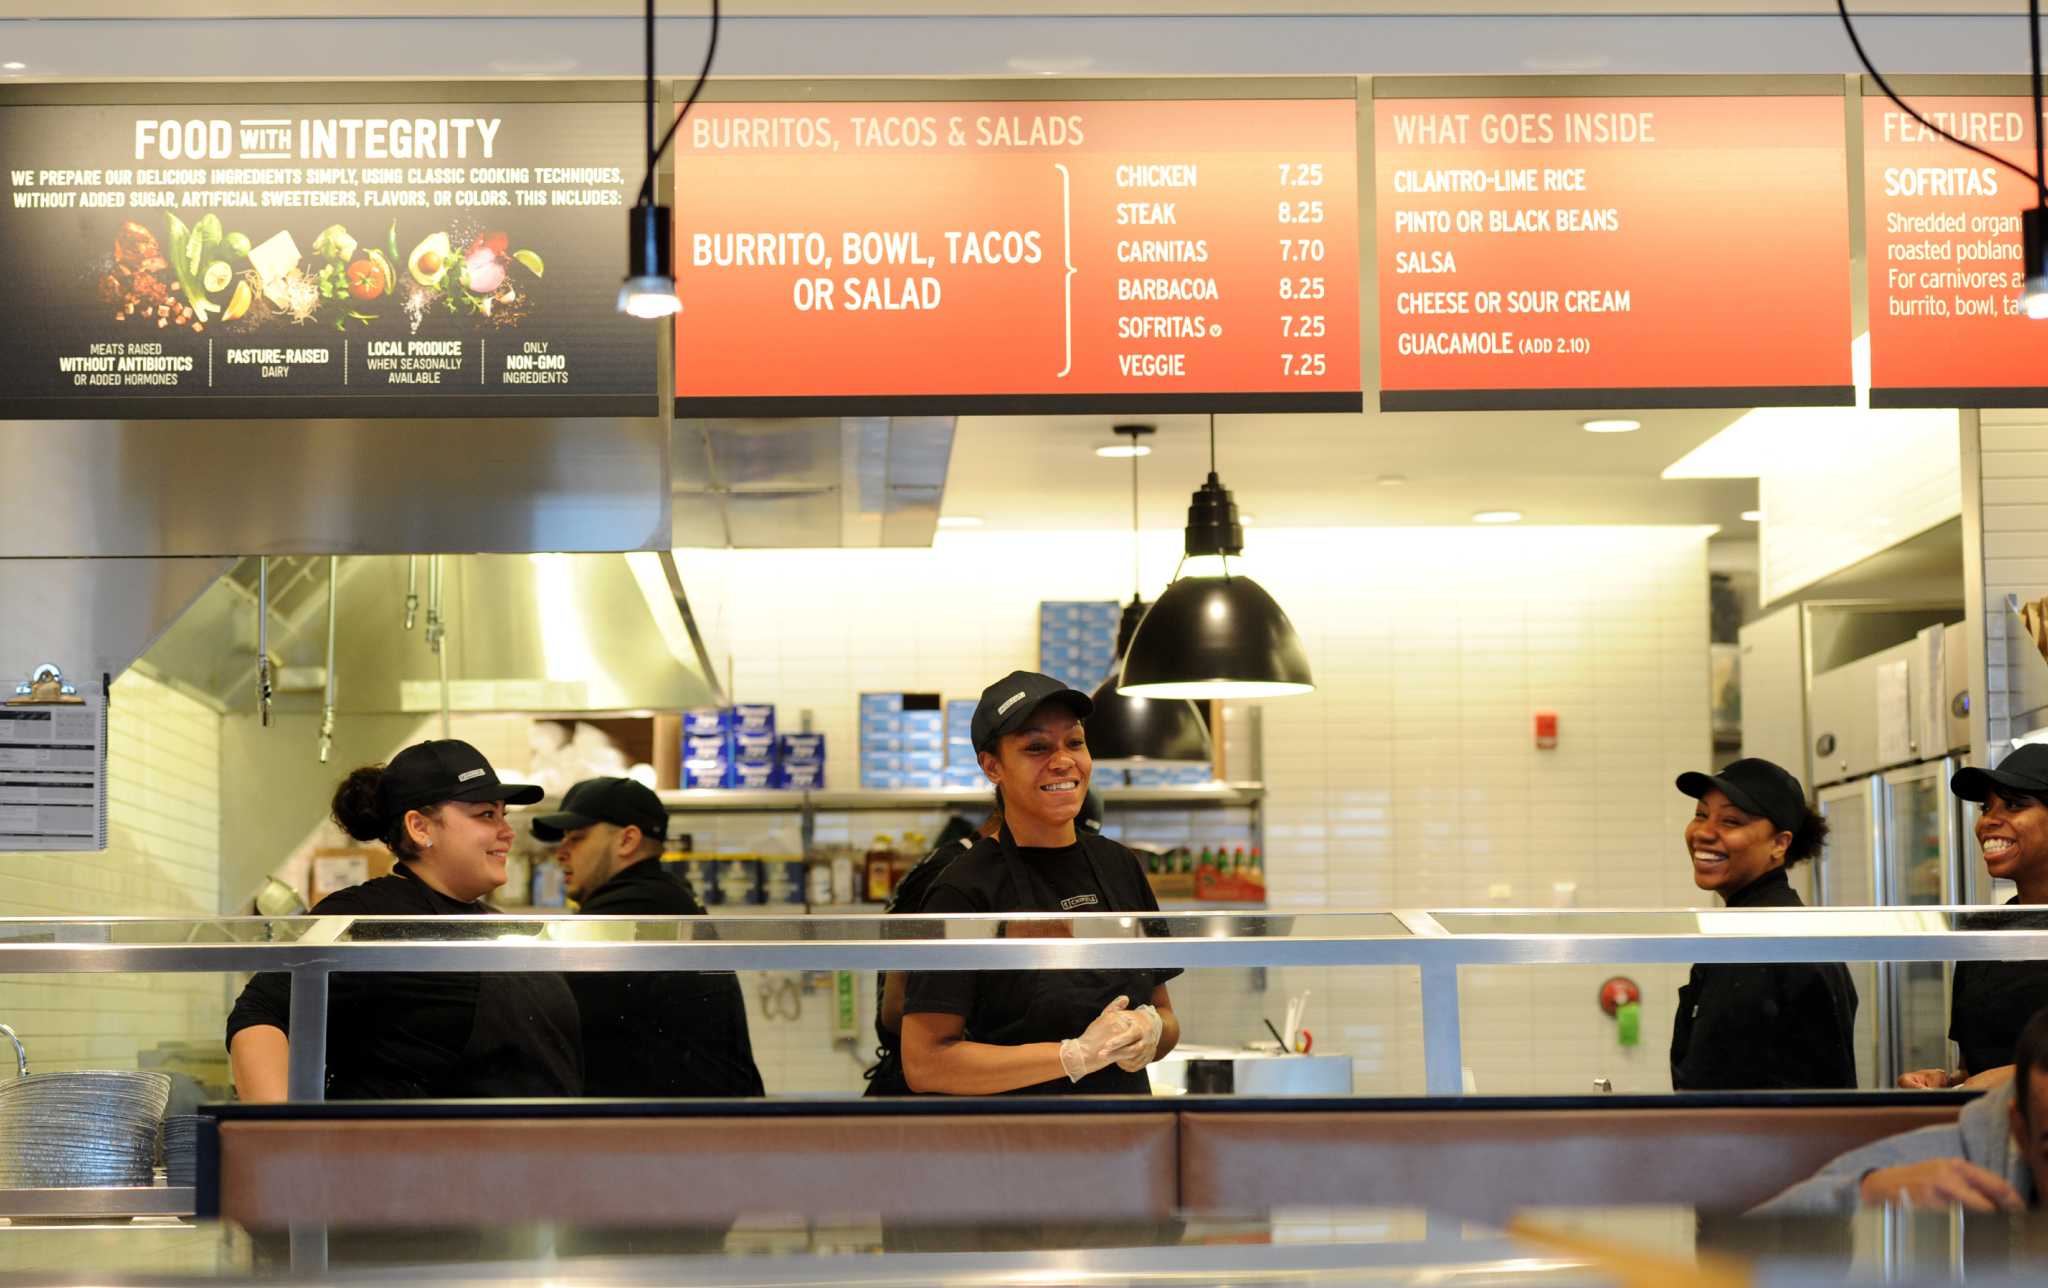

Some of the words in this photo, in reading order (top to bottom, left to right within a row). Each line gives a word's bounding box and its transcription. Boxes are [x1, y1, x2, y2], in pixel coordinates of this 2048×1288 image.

[692, 117, 840, 152] BURRITOS,
[851, 116, 937, 146] TACOS
[948, 117, 966, 146] &
[976, 116, 1083, 146] SALADS
[1393, 114, 1470, 144] WHAT
[1481, 114, 1554, 144] GOES
[1565, 112, 1655, 143] INSIDE
[1883, 112, 2024, 142] FEATURED
[135, 119, 232, 159] FOOD
[240, 129, 291, 150] WITH
[300, 118, 501, 158] INTEGRITY
[11, 170, 34, 186] WE
[40, 170, 101, 186] PREPARE
[105, 169, 132, 185] OUR
[137, 169, 206, 185] DELICIOUS
[212, 168, 301, 185] INGREDIENTS
[307, 168, 359, 186] SIMPLY,
[362, 168, 402, 184] USING
[408, 168, 464, 184] CLASSIC
[470, 168, 529, 184] COOKING
[534, 168, 624, 186] TECHNIQUES,
[1116, 164, 1197, 187] CHICKEN
[1278, 164, 1323, 186] 7.25
[1394, 169, 1538, 192] CILANTRO-LIME
[1544, 168, 1586, 191] RICE
[1884, 168, 1998, 196] SOFRITAS
[14, 192, 76, 208] WITHOUT
[79, 192, 124, 208] ADDED
[130, 191, 178, 209] SUGAR,
[182, 191, 257, 207] ARTIFICIAL
[261, 191, 360, 208] SWEETENERS,
[364, 190, 429, 208] FLAVORS,
[434, 190, 451, 206] OR
[455, 190, 511, 206] COLORS.
[515, 190, 547, 206] THIS
[552, 190, 622, 206] INCLUDES:
[1116, 202, 1176, 224] STEAK
[1278, 201, 1324, 223] 8.25
[1395, 210, 1450, 232] PINTO
[1456, 210, 1483, 232] OR
[1489, 209, 1550, 232] BLACK
[1556, 208, 1619, 231] BEANS
[1887, 212, 1966, 233] Shredded
[1971, 212, 2023, 237] organi
[692, 232, 832, 270] BURRITO,
[842, 232, 936, 268] BOWL,
[944, 230, 1042, 264] TACOS
[1117, 240, 1208, 262] CARNITAS
[1279, 240, 1325, 261] 7.70
[1888, 240, 1951, 260] roasted
[1956, 240, 2023, 264] poblano
[1396, 251, 1456, 274] SALSA
[1118, 278, 1219, 300] BARBACOA
[1279, 278, 1325, 300] 8.25
[1888, 268, 1916, 288] For
[1920, 268, 2007, 288] carnivores
[793, 278, 834, 310] OR
[843, 277, 941, 310] SALAD
[1397, 292, 1469, 314] CHEESE
[1474, 291, 1501, 314] OR
[1507, 290, 1559, 313] SOUR
[1564, 290, 1630, 312] CREAM
[1889, 296, 1950, 317] burrito,
[1955, 295, 1998, 317] bowl,
[1118, 316, 1206, 338] SOFRITAS
[1280, 316, 1326, 337] 7.25
[90, 343, 124, 355] MEATS
[128, 343, 161, 355] RAISED
[368, 341, 405, 356] LOCAL
[408, 341, 462, 356] PRODUCE
[523, 342, 548, 353] ONLY
[1398, 332, 1514, 355] GUACAMOLE
[1518, 338, 1552, 354] (ADD
[1557, 338, 1590, 354] 2.10)
[60, 357, 115, 371] WITHOUT
[118, 357, 193, 371] ANTIBIOTICS
[227, 349, 329, 364] PASTURE-RAISED
[367, 358, 398, 370] WHEN
[400, 358, 462, 370] SEASONALLY
[507, 355, 565, 370] NON-GMO
[1119, 354, 1186, 376] VEGGIE
[1281, 354, 1326, 376] 7.25
[74, 374, 86, 386] OR
[90, 374, 121, 385] ADDED
[124, 374, 178, 385] HORMONES
[262, 366, 289, 378] DAIRY
[388, 372, 441, 384] AVAILABLE
[503, 372, 568, 384] INGREDIENTS
